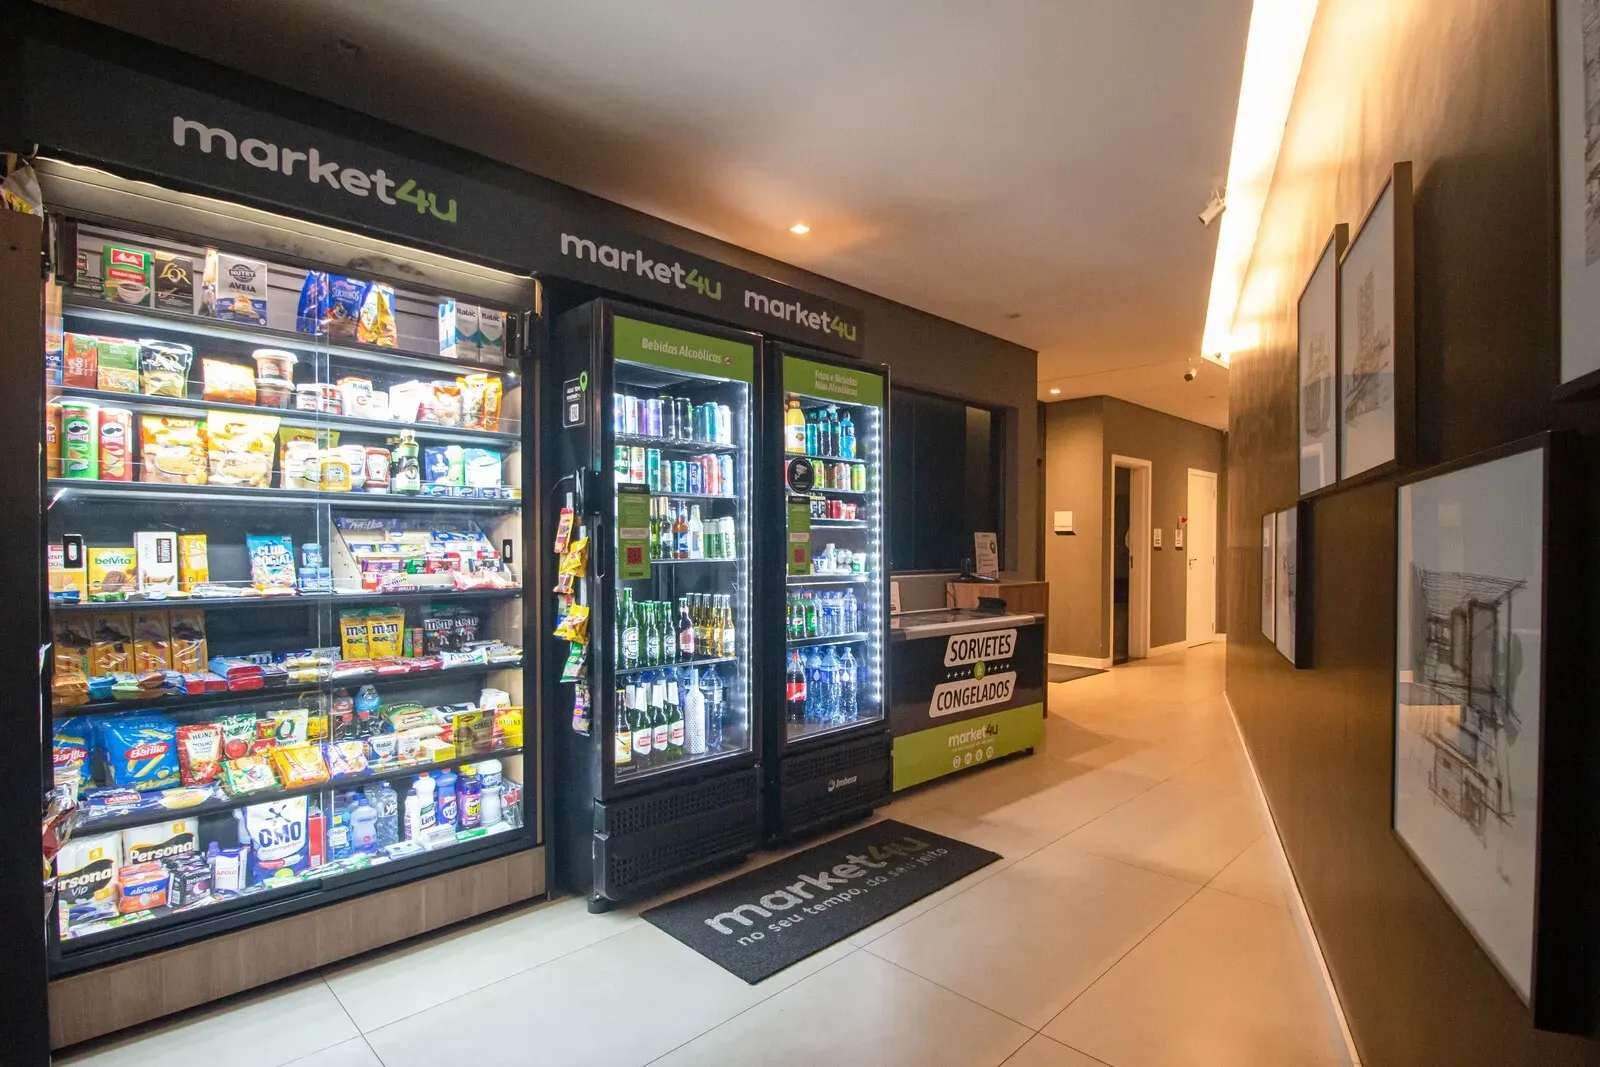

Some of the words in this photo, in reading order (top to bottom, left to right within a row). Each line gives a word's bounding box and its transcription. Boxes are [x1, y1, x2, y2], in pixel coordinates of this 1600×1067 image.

[173, 116, 457, 224] market4u
[230, 269, 255, 277] NUTRY
[560, 232, 722, 300] market4u
[229, 282, 256, 293] AVEIA
[744, 288, 857, 342] market4u
[642, 337, 678, 356] Bebidas
[254, 553, 292, 566] SOCIAL
[257, 544, 285, 555] CLUB
[94, 555, 132, 566] belVita
[950, 634, 1012, 662] SORVETES
[936, 679, 1010, 711] CONGELADOS
[192, 731, 213, 739] HEINZ
[948, 724, 998, 747] market4u
[130, 743, 166, 759] Barilla
[259, 821, 302, 848] OMO
[130, 836, 195, 864] Personal
[71, 885, 89, 897] Vip
[130, 884, 158, 896] always
[704, 837, 930, 935] market4u
[737, 930, 765, 946] no
[768, 913, 804, 932] seu
[803, 886, 868, 915] tempo,
[866, 874, 888, 887] do
[888, 861, 916, 877] seu
[917, 847, 949, 866] jeito
